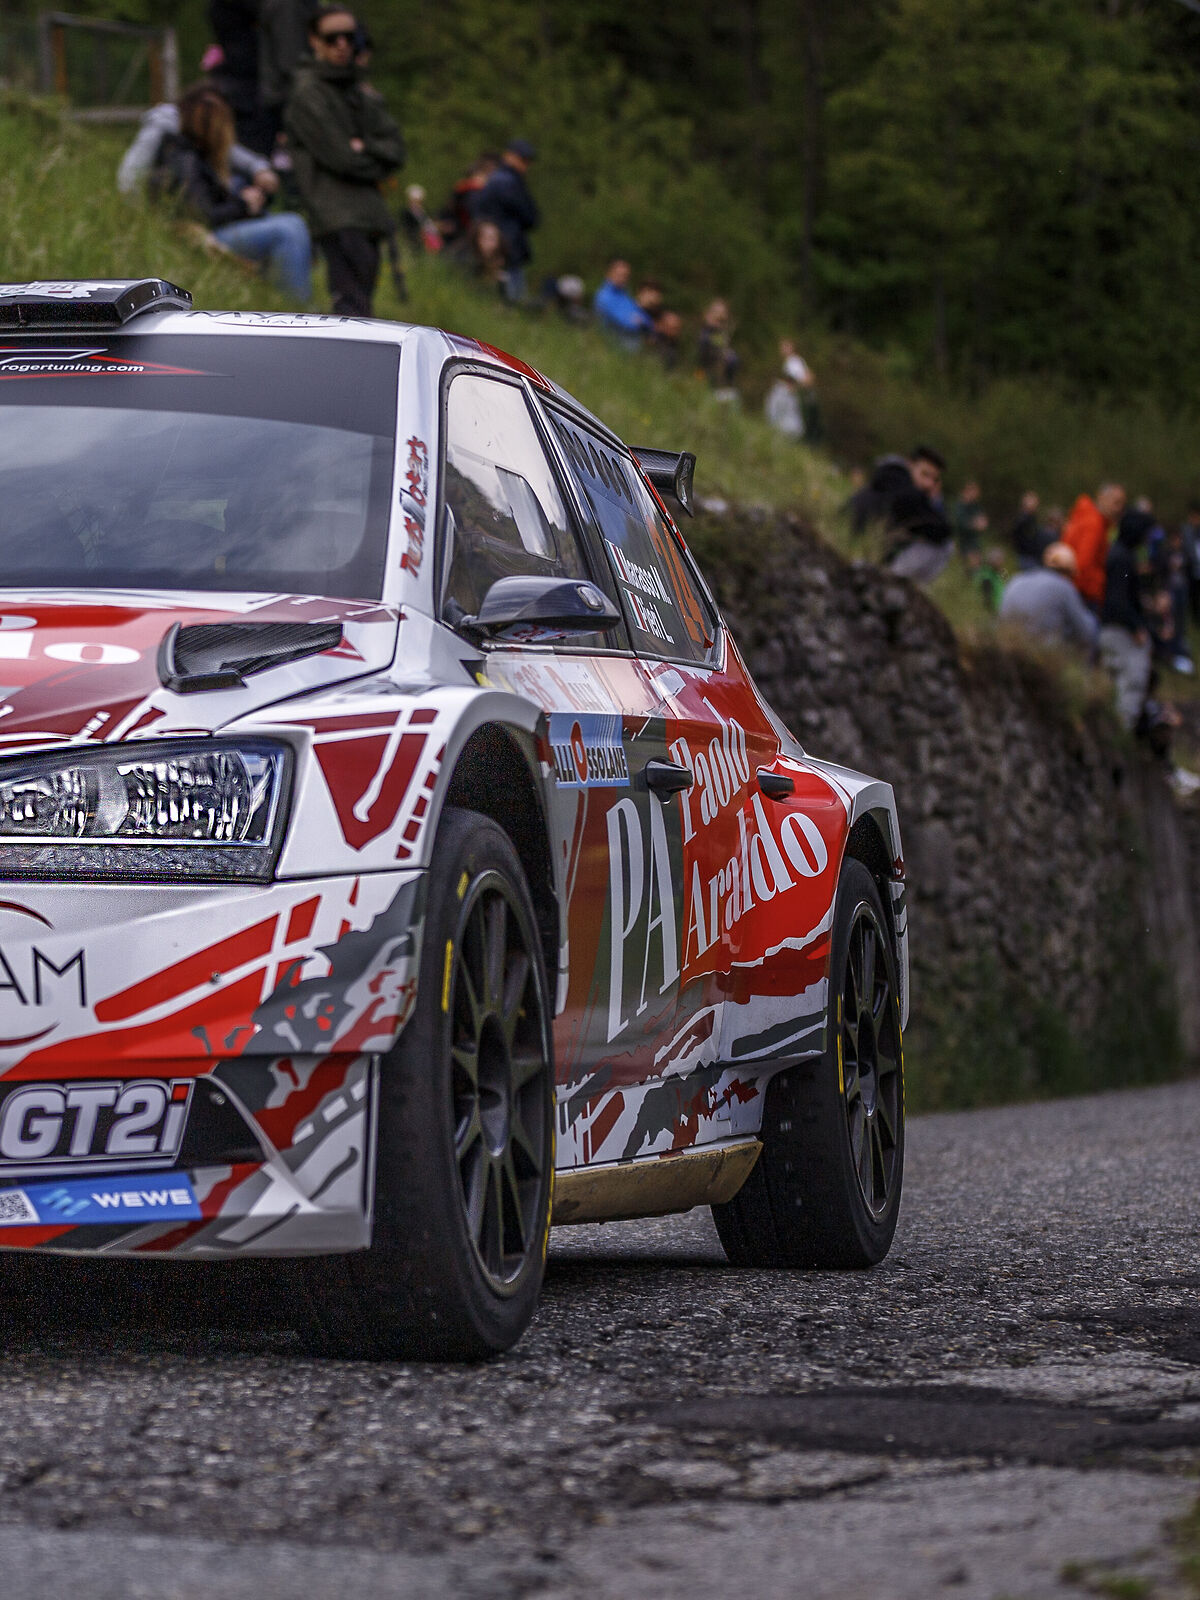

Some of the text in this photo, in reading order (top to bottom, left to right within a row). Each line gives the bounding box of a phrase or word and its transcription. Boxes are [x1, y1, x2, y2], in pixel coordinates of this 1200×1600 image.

[0, 362, 145, 373] rogertuning.com
[570, 719, 630, 785] OSSOLANE
[668, 696, 751, 848] Paolo
[605, 785, 681, 1044] PA
[682, 791, 830, 972] Araldo
[0, 1082, 190, 1161] GT2i
[91, 1186, 192, 1210] WEWE
